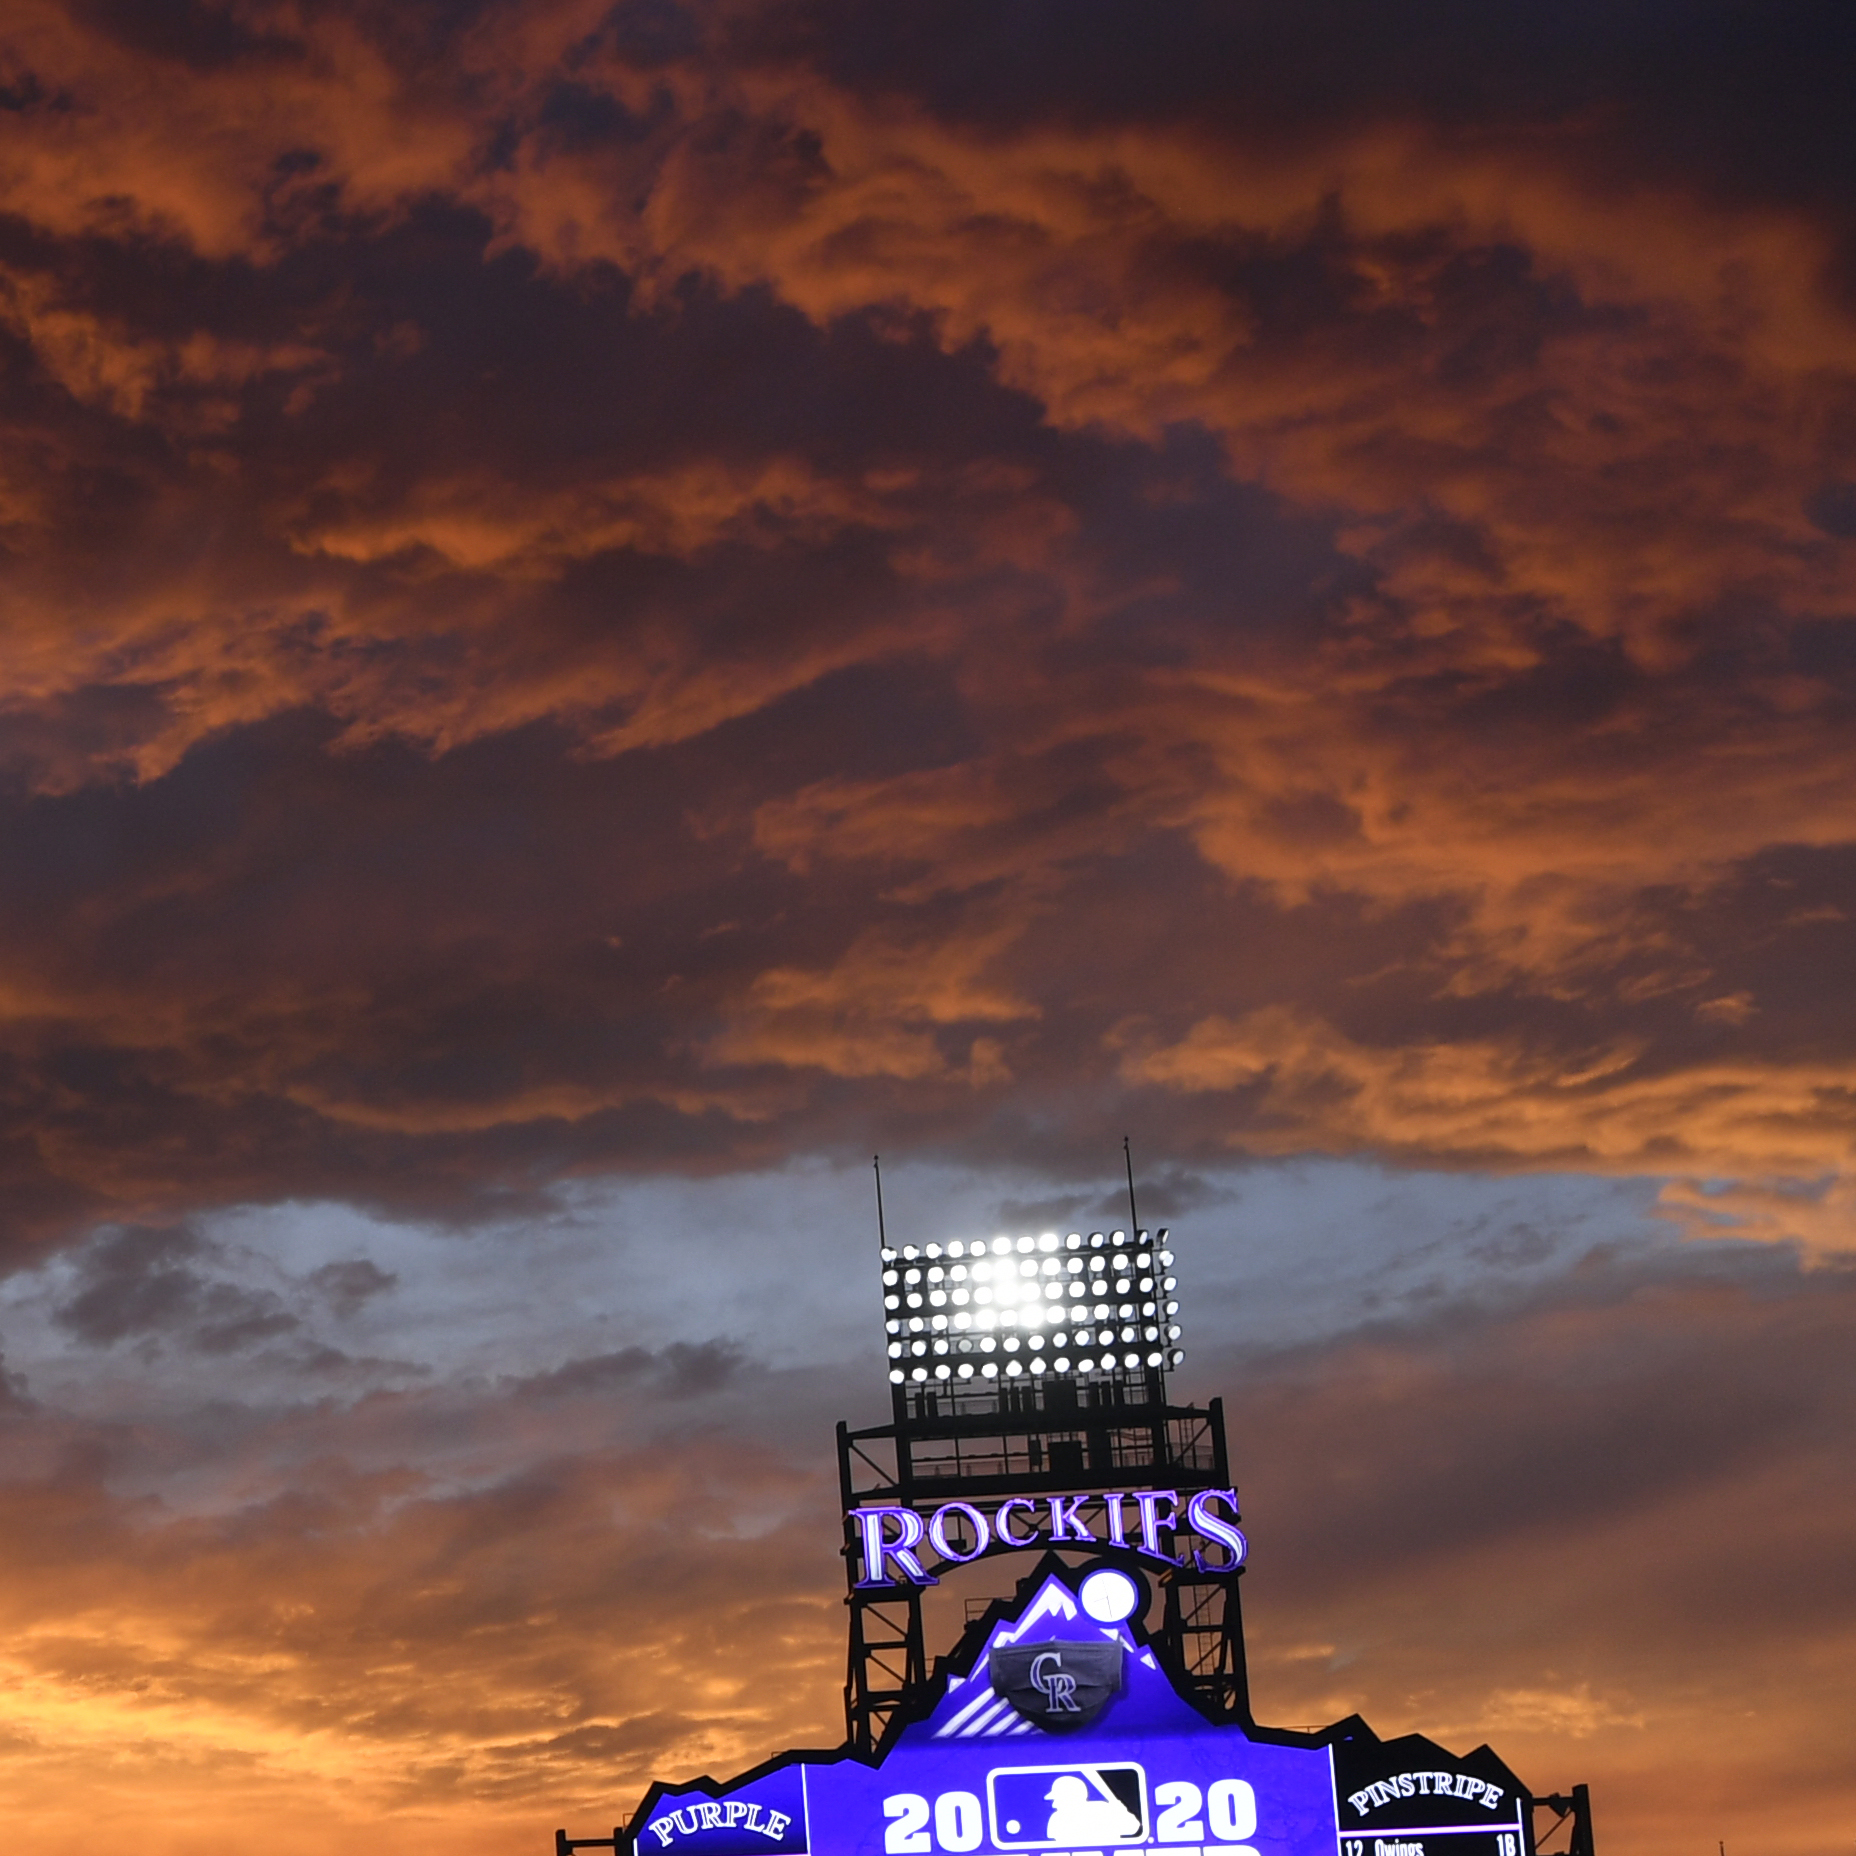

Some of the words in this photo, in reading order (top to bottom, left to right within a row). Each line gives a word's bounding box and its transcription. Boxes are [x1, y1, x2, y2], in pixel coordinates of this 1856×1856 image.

[847, 1487, 1248, 1589] ROCKIES
[1347, 1771, 1504, 1817] PINSTRIPE
[648, 1801, 792, 1848] PURPLE
